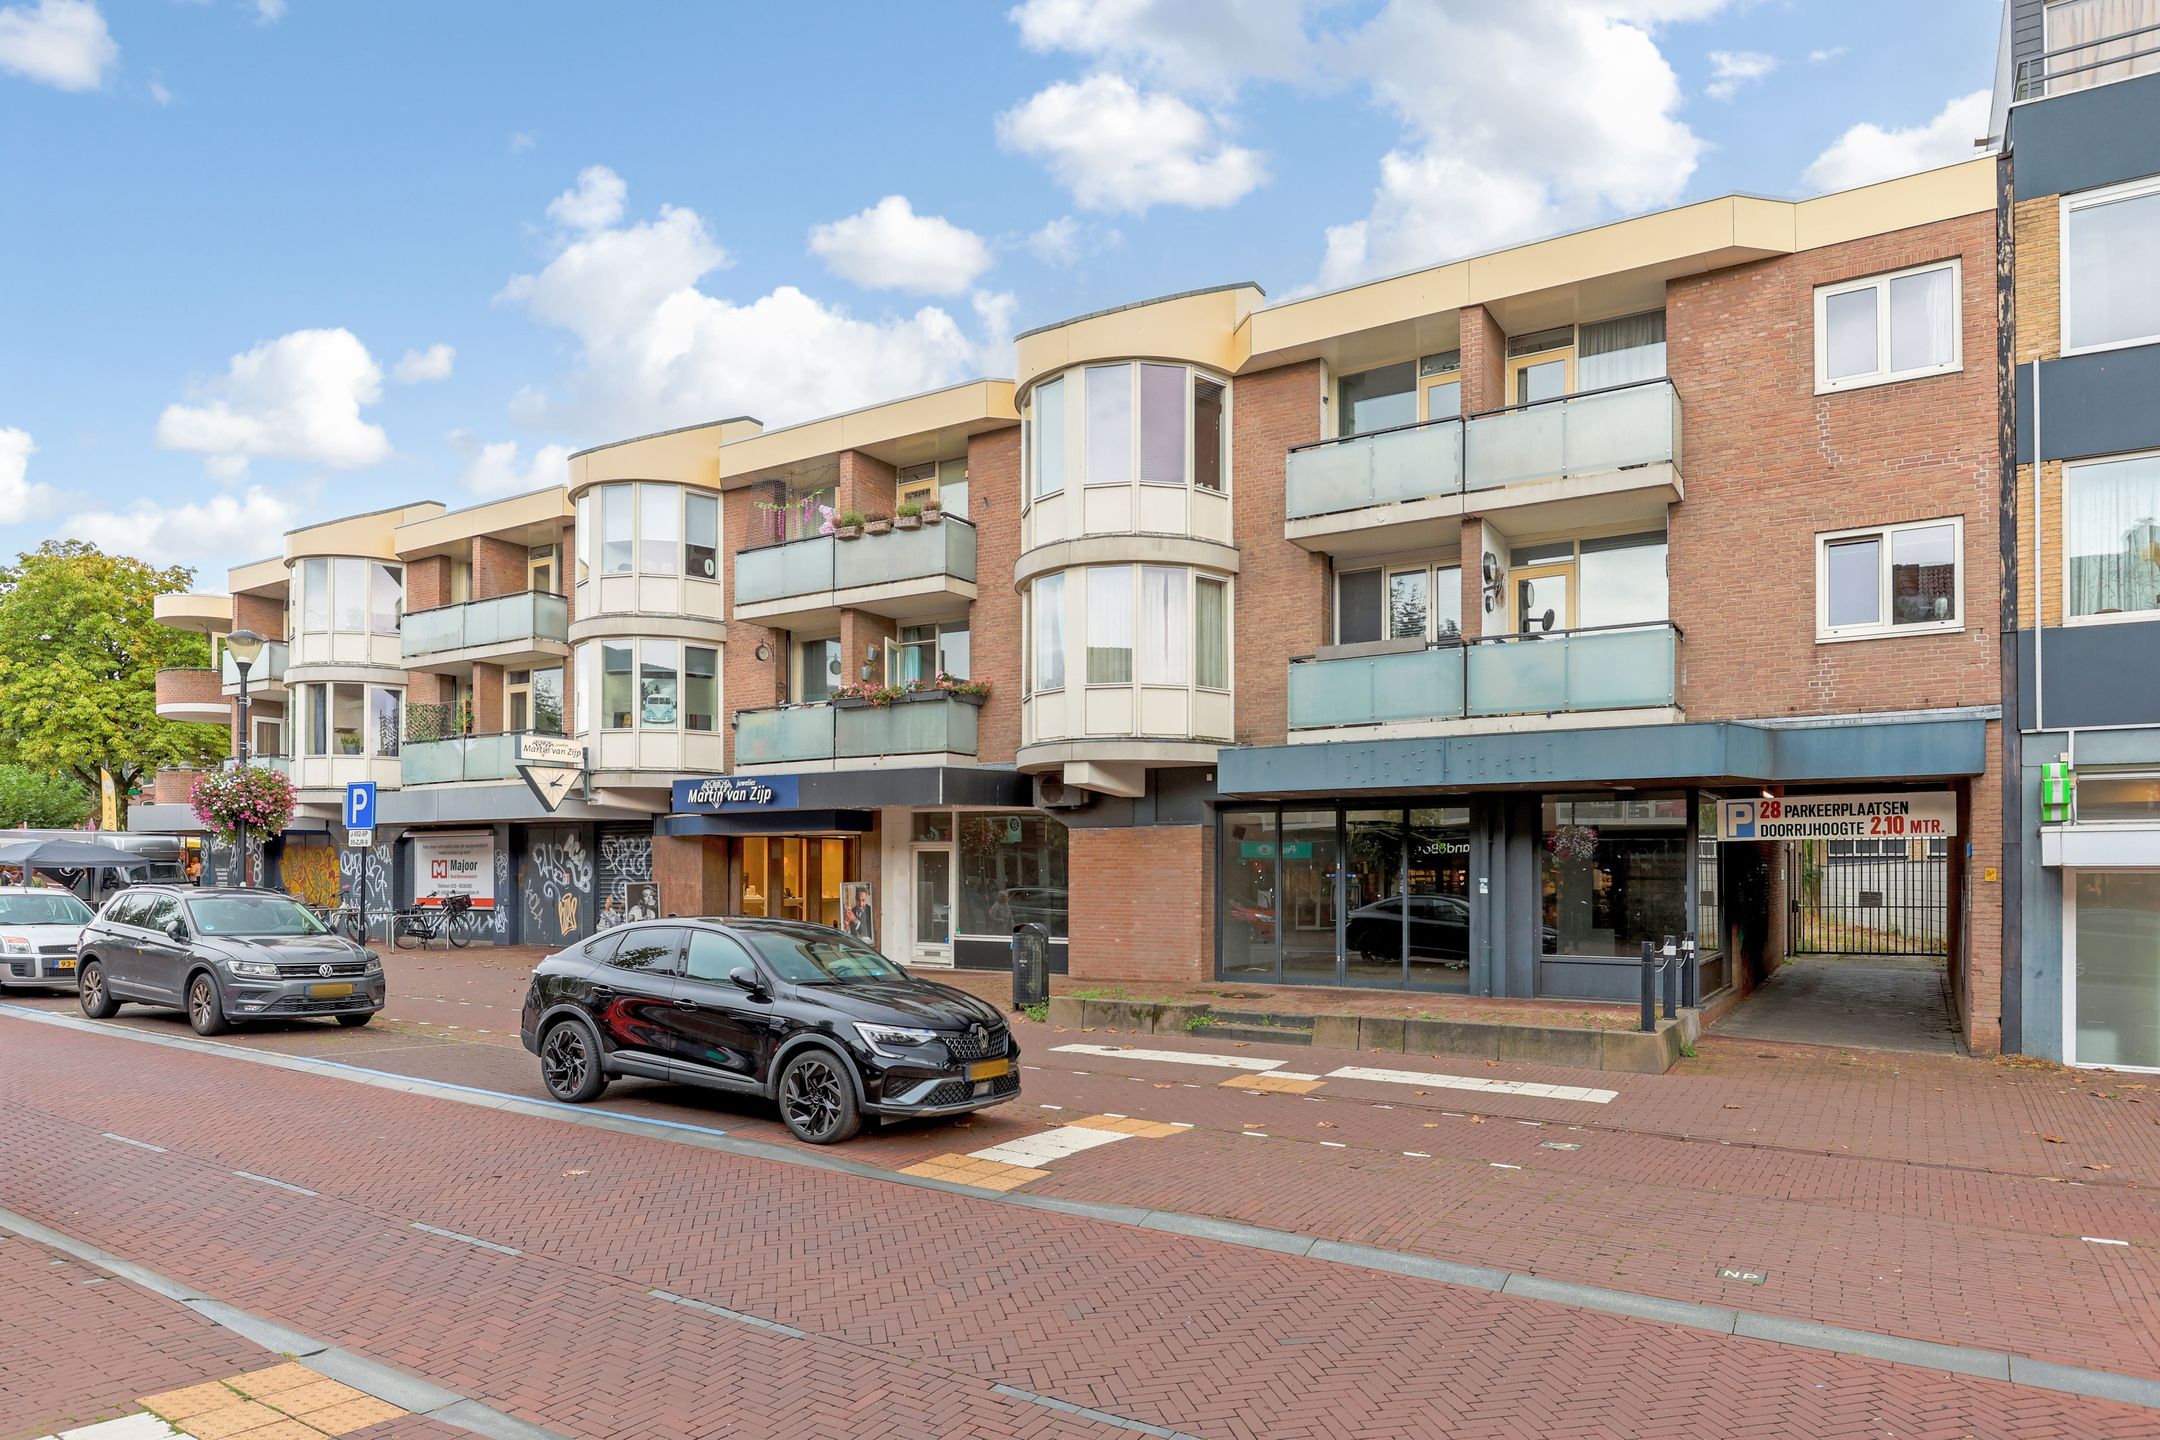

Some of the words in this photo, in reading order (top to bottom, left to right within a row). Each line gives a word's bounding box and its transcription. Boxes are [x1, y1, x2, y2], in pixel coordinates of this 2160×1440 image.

[523, 744, 550, 755] Martin
[567, 748, 582, 758] Zijp
[687, 789, 723, 803] Martin
[726, 789, 746, 801] van
[749, 785, 772, 804] Zijp
[352, 788, 368, 824] P
[1728, 804, 1752, 836] P
[1760, 800, 1781, 819] 28
[1784, 801, 1909, 818] PARKEERPLAATSEN
[1760, 821, 1864, 838] DOORRIJHOOGTE
[1870, 816, 1904, 836] 2,10
[1910, 819, 1945, 834] MTR.
[450, 859, 478, 873] Majoor
[1723, 1269, 1759, 1280] NP
